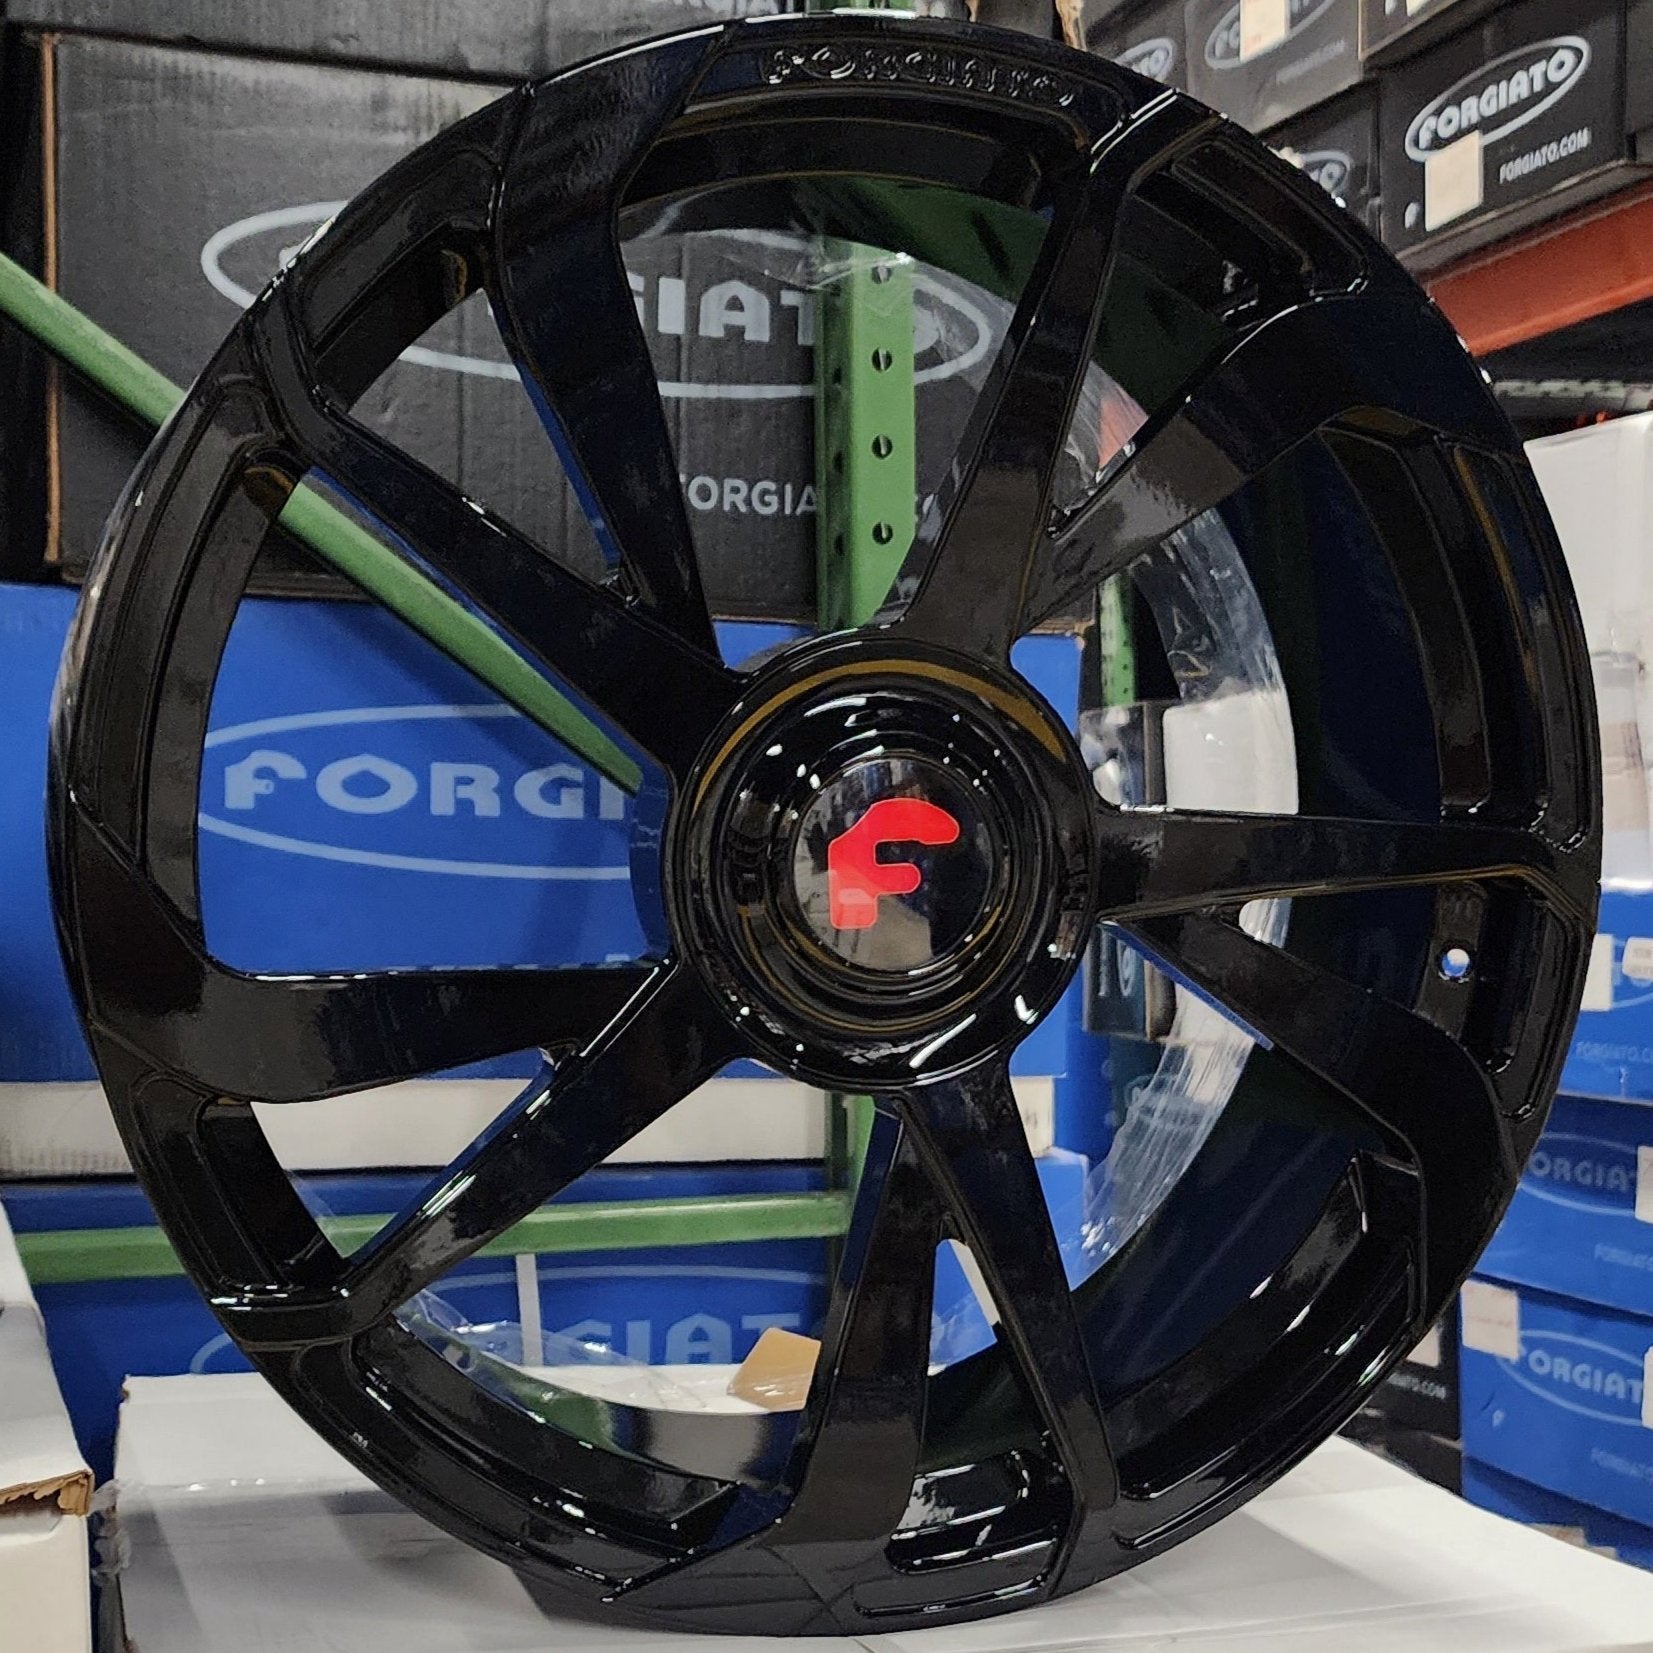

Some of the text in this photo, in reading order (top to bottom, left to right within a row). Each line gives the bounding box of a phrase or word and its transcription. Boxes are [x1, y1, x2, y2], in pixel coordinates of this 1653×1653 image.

[1418, 48, 1578, 150] FORGIATO
[1500, 127, 1592, 184] FORGIATO.COM
[679, 473, 817, 516] ORGIA
[828, 798, 960, 929] F
[1528, 1151, 1637, 1192] ORGIA
[1520, 1347, 1644, 1404] ORGIAT
